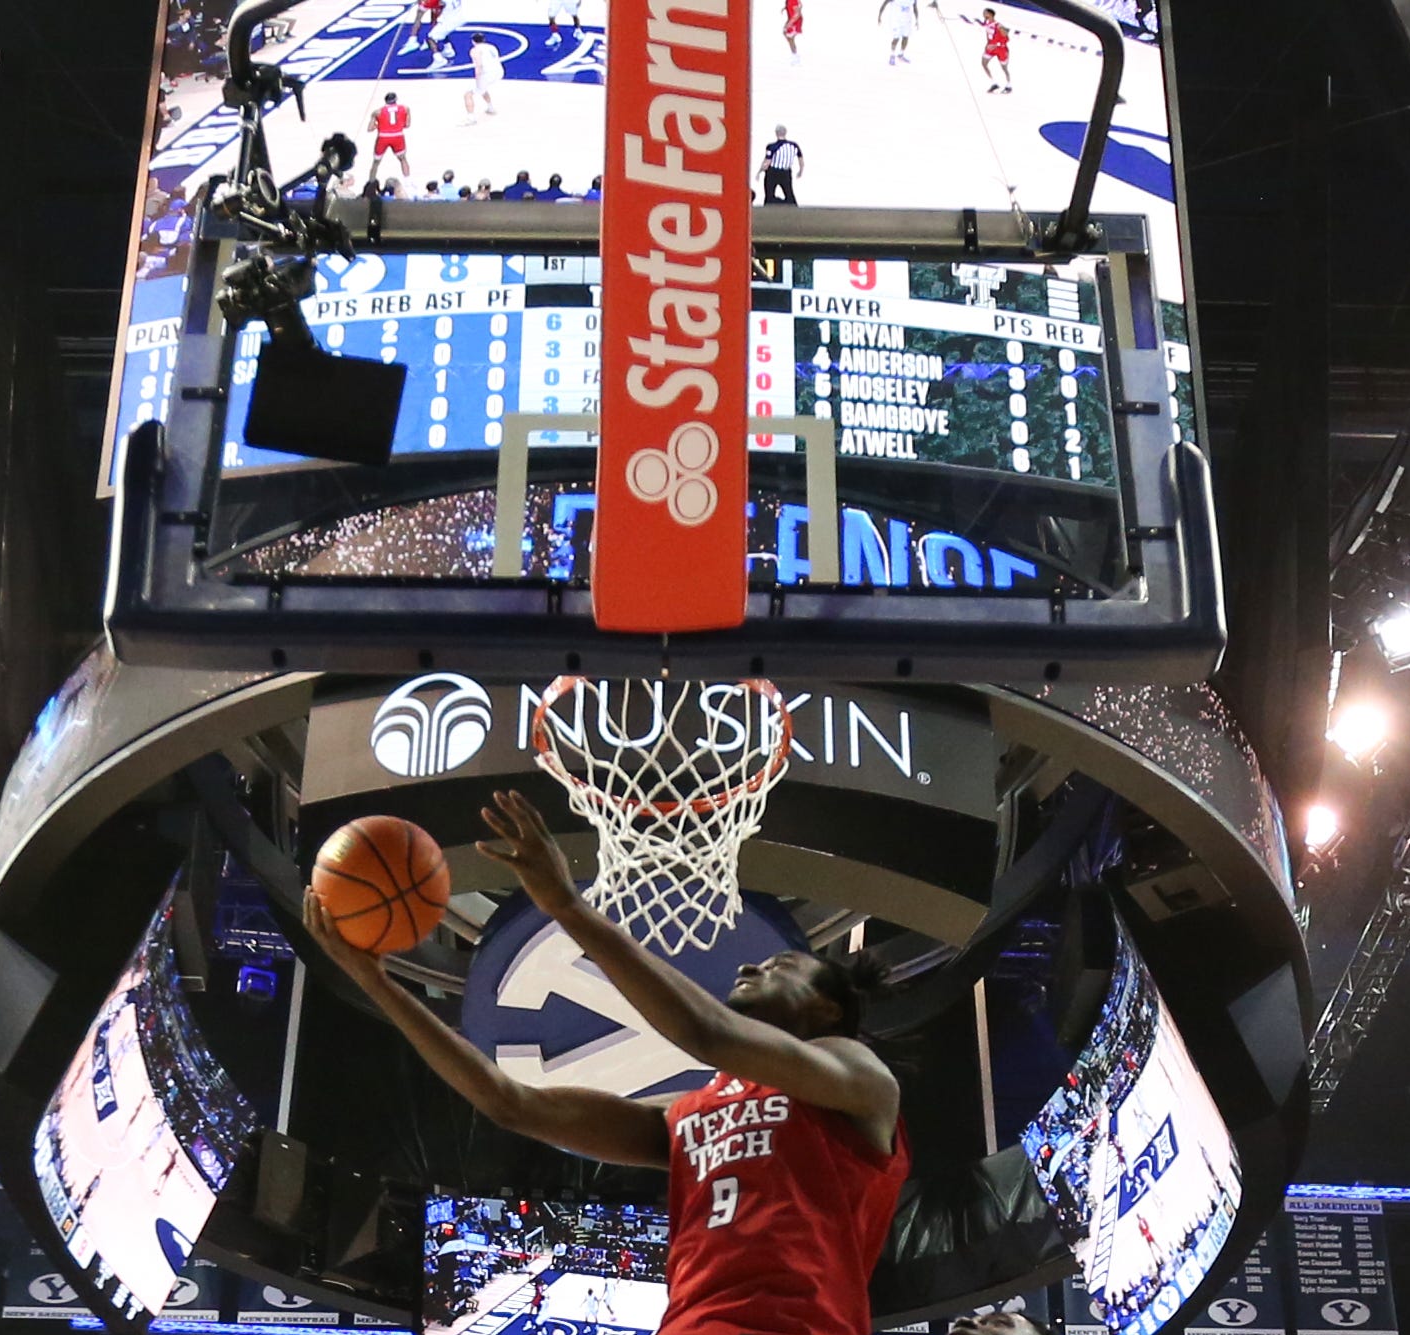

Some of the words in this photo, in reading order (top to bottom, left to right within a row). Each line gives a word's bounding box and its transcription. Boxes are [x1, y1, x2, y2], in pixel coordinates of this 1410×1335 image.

[849, 259, 877, 291] 9
[318, 298, 358, 319] PTS
[372, 294, 411, 315] REB
[425, 291, 466, 310] AST
[487, 289, 513, 306] PF
[800, 294, 881, 317] PLAYER
[382, 320, 399, 343] 2
[435, 315, 452, 339] 0
[490, 313, 508, 337] 0
[546, 314, 562, 331] 6
[758, 319, 768, 335] 1
[994, 314, 1033, 336] PTS
[1046, 323, 1085, 344] REB
[433, 342, 451, 366] 0
[488, 340, 506, 363] 0
[545, 341, 561, 359] 3
[756, 345, 772, 363] 5
[819, 321, 831, 344] 1
[840, 321, 905, 350] BRYAN
[1007, 341, 1024, 364] 0
[1059, 349, 1076, 373] 0
[435, 369, 447, 393] 1
[487, 367, 505, 390] 0
[544, 368, 559, 386] 0
[756, 373, 772, 390] 0
[812, 346, 831, 371] 4
[840, 347, 943, 381] ANDERSON
[1060, 375, 1078, 399] 0
[430, 396, 448, 421] 0
[486, 394, 504, 418] 0
[840, 374, 929, 405] MOSELEY
[1009, 393, 1027, 418] 0
[1064, 402, 1077, 426] 1
[428, 424, 446, 449] 0
[484, 421, 502, 446] 0
[840, 401, 949, 435] BAMGBOYE
[1010, 421, 1028, 445] 0
[1065, 428, 1082, 453] 2
[840, 428, 918, 459] ATWELL
[1068, 456, 1081, 481] 1
[518, 680, 663, 750] NU
[675, 1095, 789, 1152] TEXAS
[690, 1129, 773, 1182] TECH
[707, 1176, 739, 1229] 9
[274, 1316, 337, 1324] BASKETBALL
